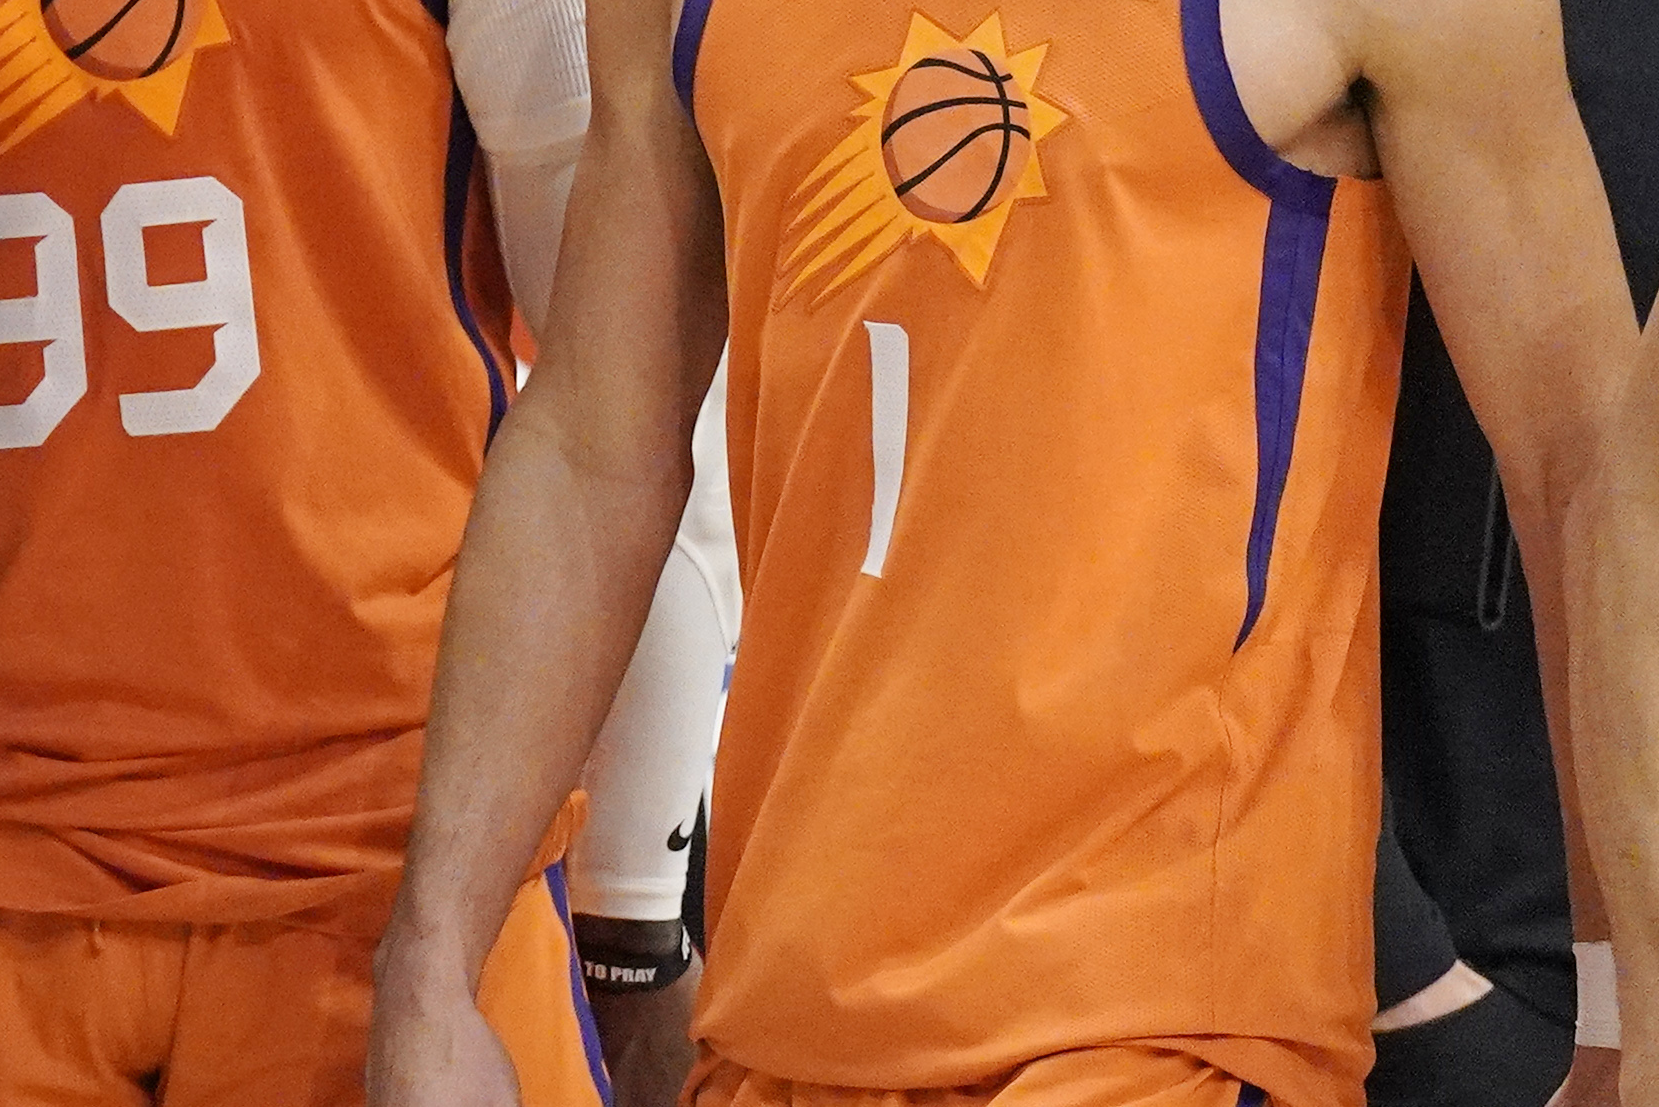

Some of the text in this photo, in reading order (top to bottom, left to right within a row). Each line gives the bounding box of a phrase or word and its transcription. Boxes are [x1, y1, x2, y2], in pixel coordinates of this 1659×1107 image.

[860, 320, 910, 578] 1
[583, 960, 657, 983] TO PRAY
